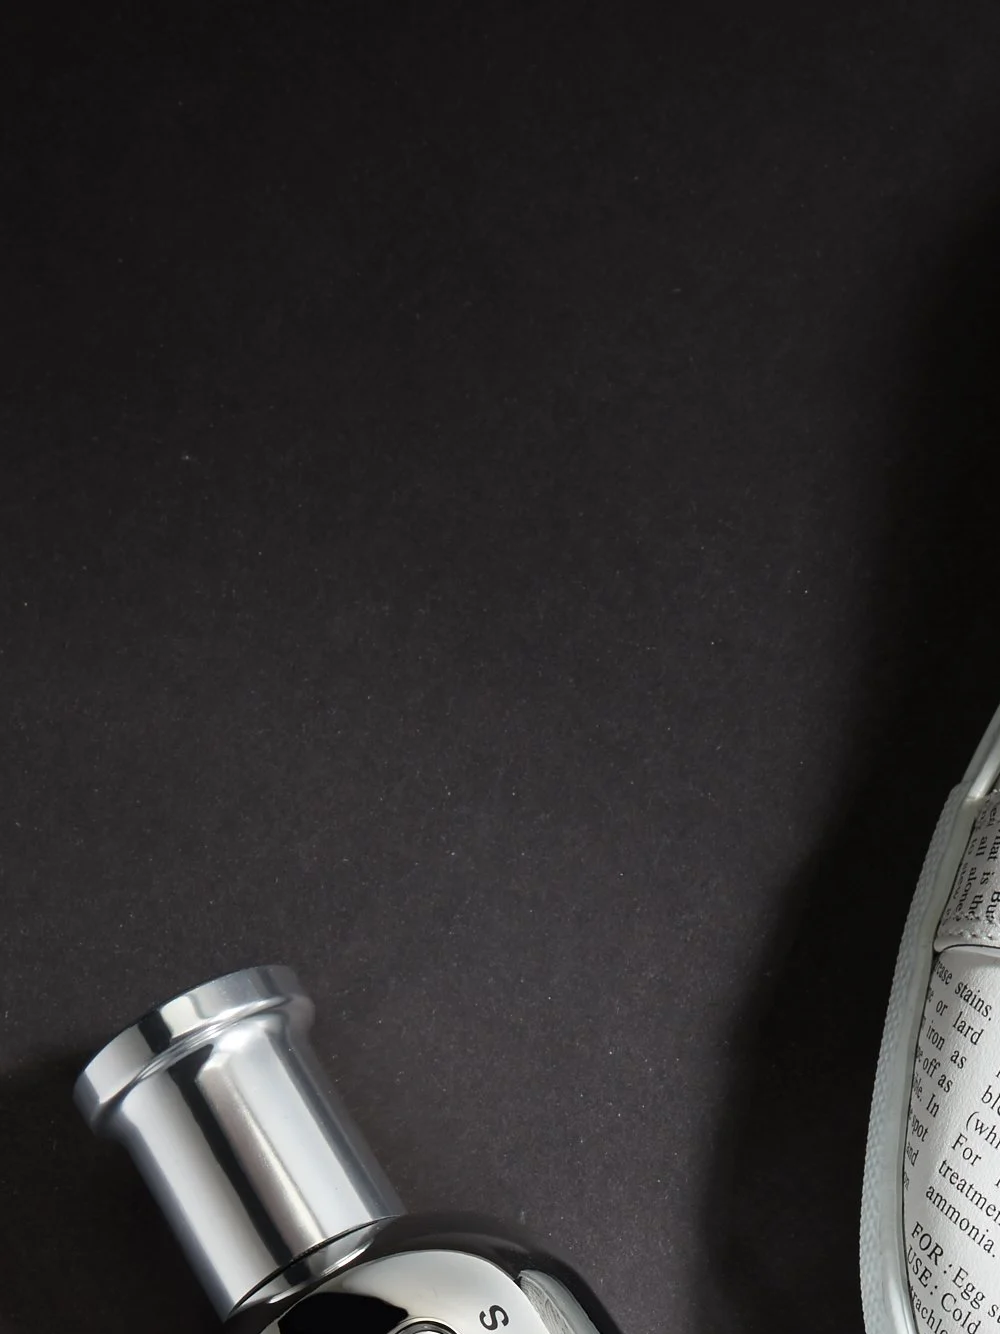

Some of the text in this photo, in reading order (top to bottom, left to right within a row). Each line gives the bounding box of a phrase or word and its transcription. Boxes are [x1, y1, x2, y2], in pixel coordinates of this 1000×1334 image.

[955, 982, 993, 1022] stains.
[952, 1009, 985, 1046] lard
[950, 1131, 983, 1168] For
[924, 1185, 997, 1259] ammonia.
[949, 1266, 986, 1310] Egg
